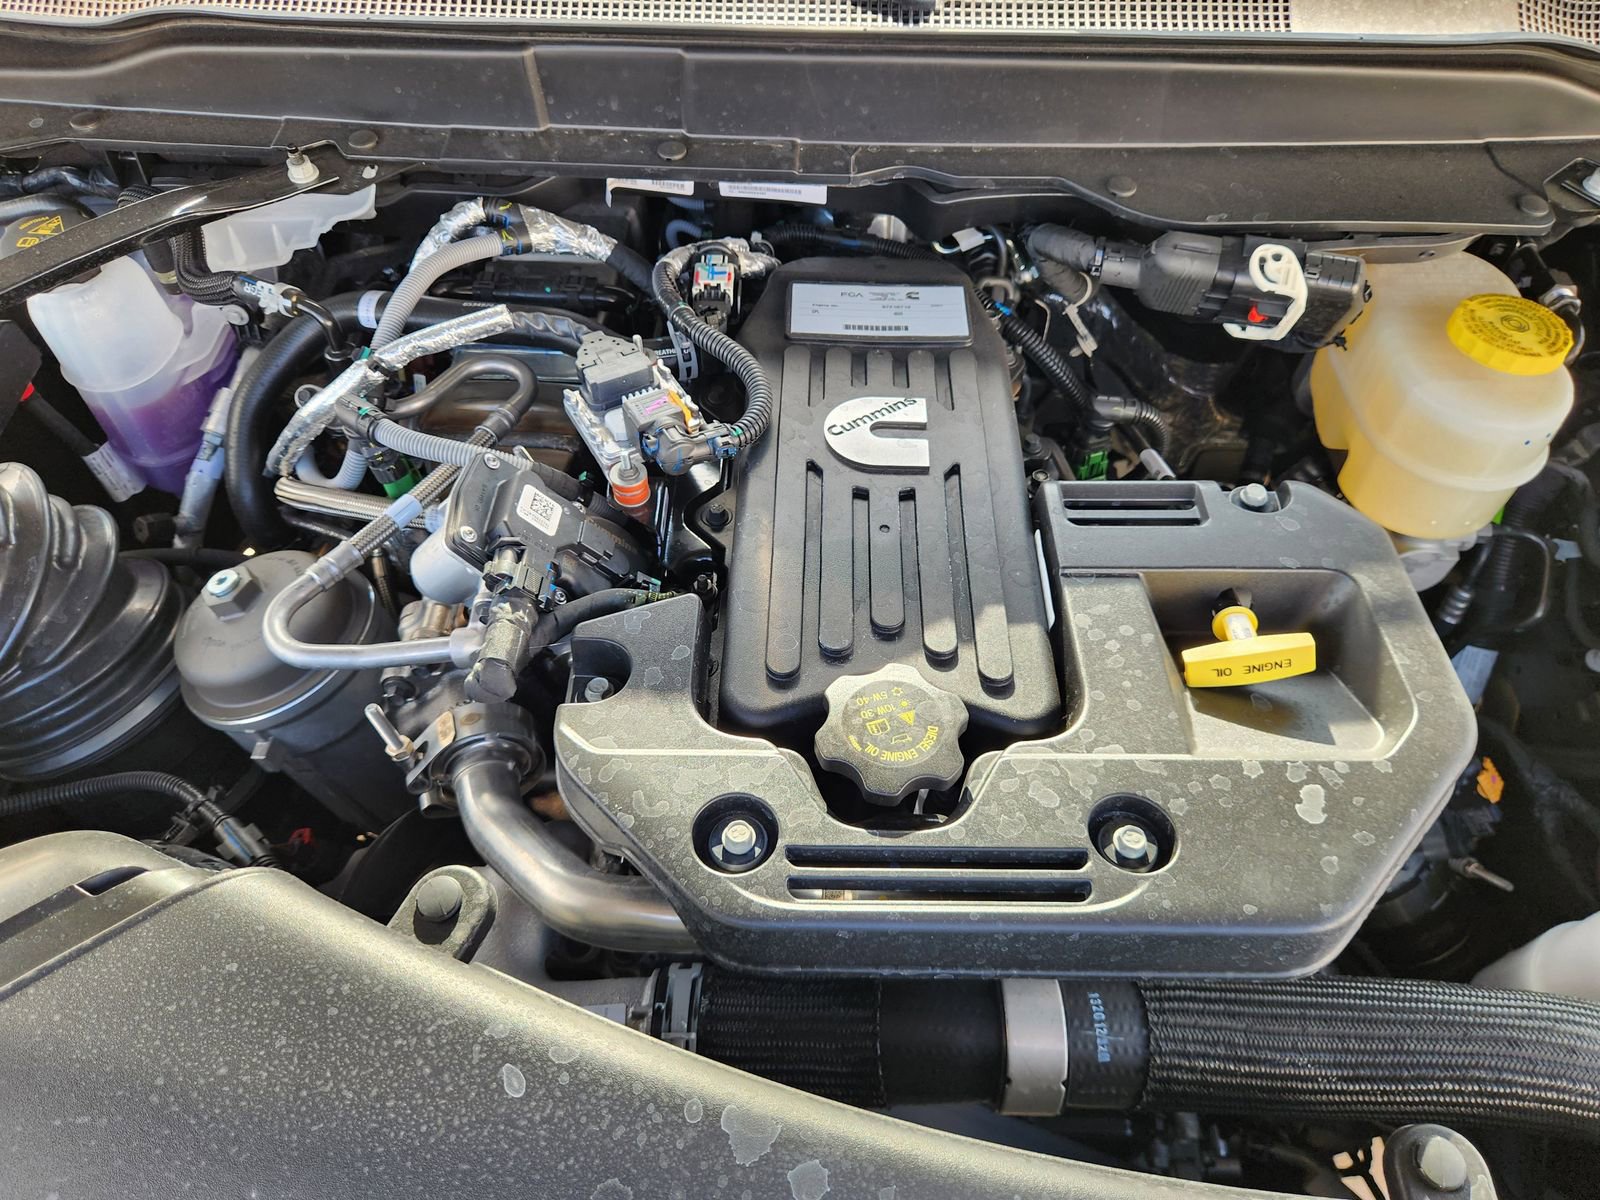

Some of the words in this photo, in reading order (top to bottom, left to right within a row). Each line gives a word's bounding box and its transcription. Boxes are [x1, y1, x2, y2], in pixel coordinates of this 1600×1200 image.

[827, 398, 917, 436] Cummins
[1211, 667, 1232, 678] OIL
[1242, 658, 1292, 674] ENGINE
[918, 725, 939, 752] DIESEL
[865, 741, 880, 757] OIL
[880, 748, 919, 762] ENGINE
